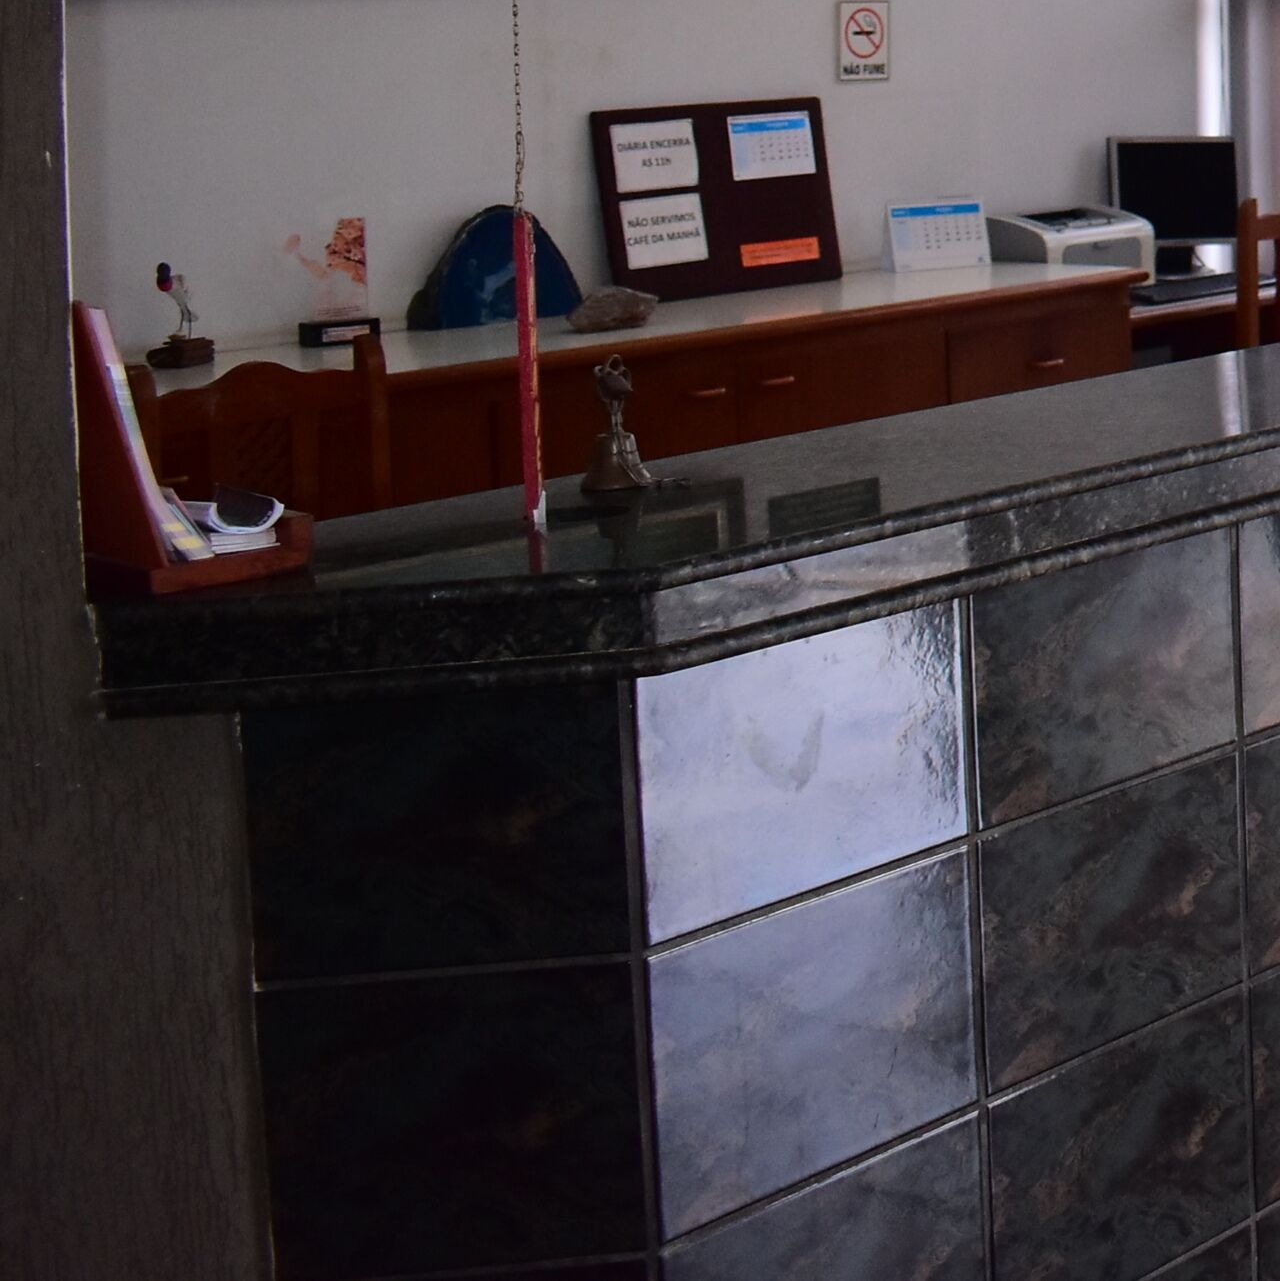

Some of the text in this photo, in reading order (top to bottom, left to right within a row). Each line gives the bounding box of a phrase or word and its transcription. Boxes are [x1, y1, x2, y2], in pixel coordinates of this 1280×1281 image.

[843, 63, 885, 75] NÃO FUME
[650, 137, 691, 150] ENCERRA
[627, 212, 697, 228] NÃO SERVIMOS
[651, 233, 664, 244] DA
[667, 227, 701, 241] MANHÃ
